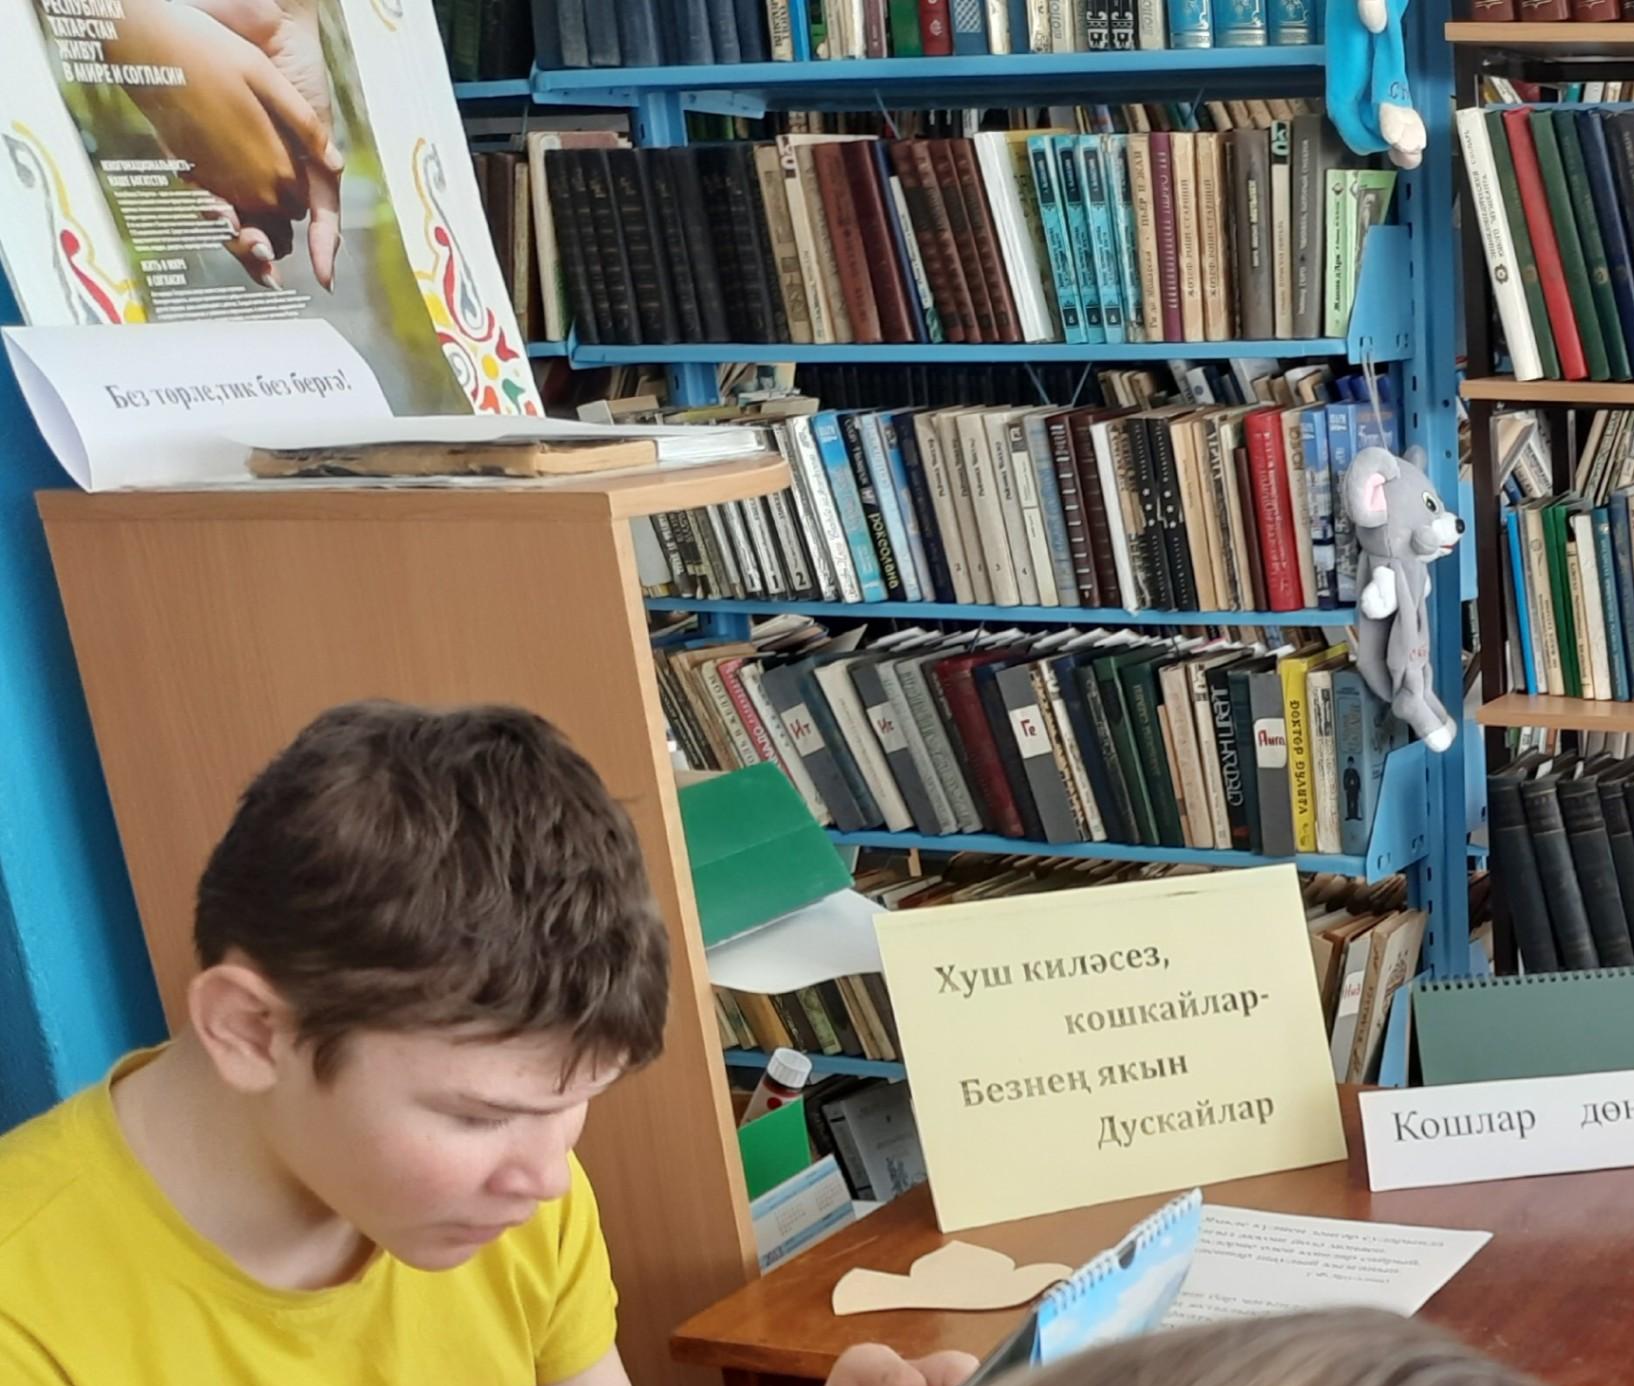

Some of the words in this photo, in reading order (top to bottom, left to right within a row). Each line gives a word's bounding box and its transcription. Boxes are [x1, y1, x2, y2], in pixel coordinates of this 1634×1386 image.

[47, 15, 119, 40] ТАТАРСТАН
[55, 39, 104, 61] ЖИВУТ
[62, 62, 74, 82] В
[74, 63, 113, 83] МИРЕ
[122, 65, 186, 86] СОГЛАСИИ
[104, 385, 150, 409] Без
[256, 375, 290, 397] без
[933, 961, 1013, 999] Хуш
[1021, 944, 1172, 982] киләсез,
[1064, 990, 1270, 1035] кошкайлар-
[958, 1066, 1091, 1107] Безнең
[1098, 1053, 1189, 1087] якын
[1097, 1094, 1275, 1150] Дускайлар
[1392, 1106, 1537, 1142] Кошлар
